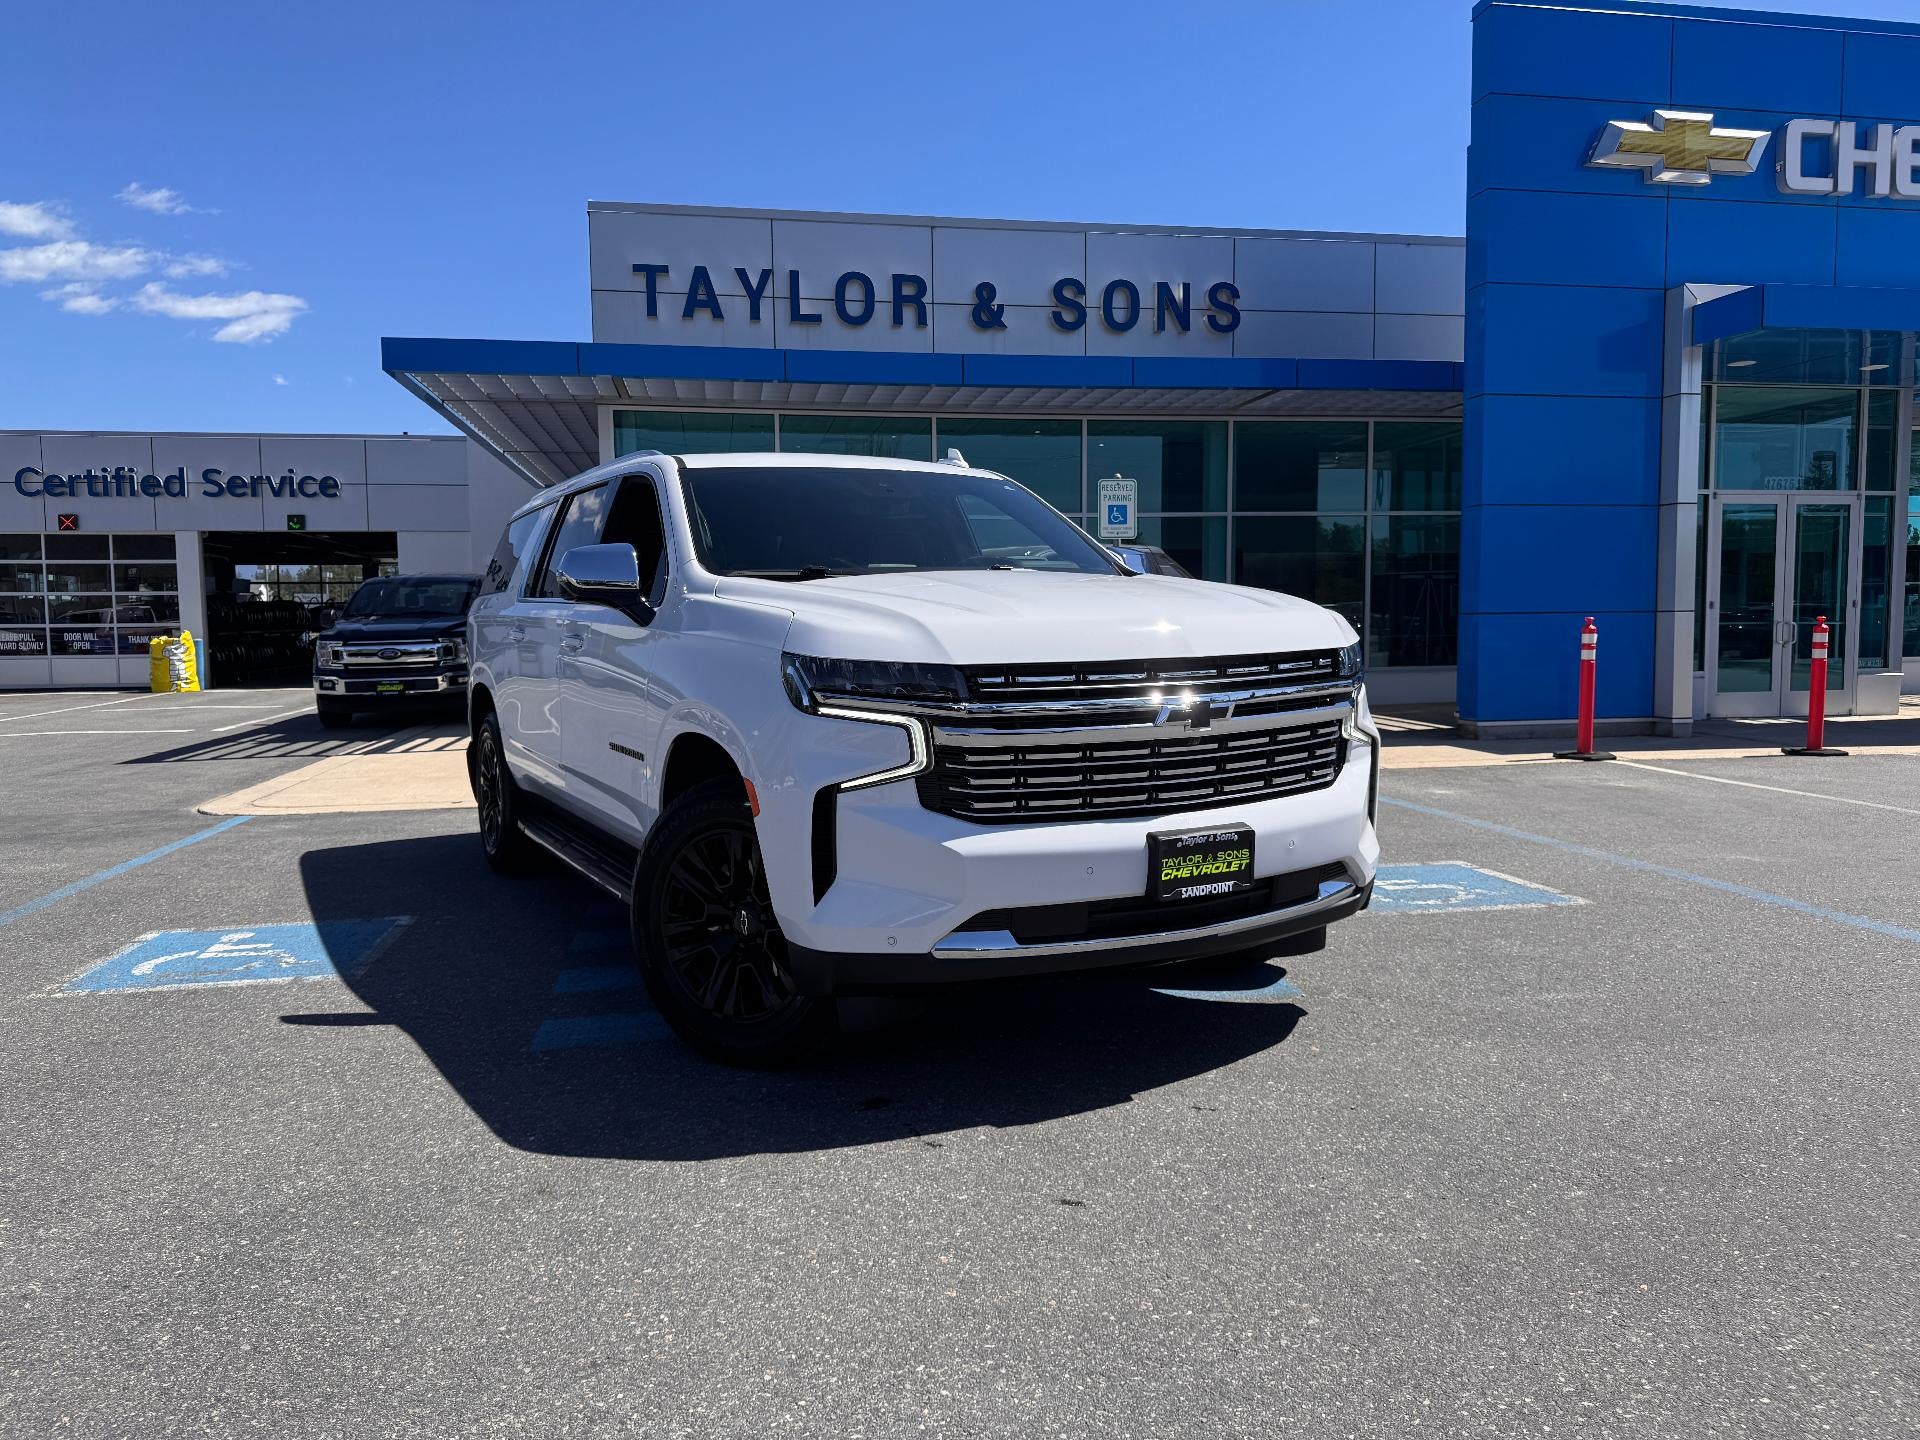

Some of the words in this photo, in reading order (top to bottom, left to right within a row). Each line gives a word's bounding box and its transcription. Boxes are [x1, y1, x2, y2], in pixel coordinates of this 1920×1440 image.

[632, 264, 928, 327] TAYLOR
[971, 281, 1008, 329] &
[1052, 277, 1241, 333] SONS
[14, 466, 188, 498] Certified
[202, 467, 342, 498] Service
[1101, 484, 1134, 492] RESERVED
[1103, 494, 1132, 502] PARKING
[19, 633, 36, 641] PULL
[63, 632, 82, 641] DOOR
[83, 632, 99, 641] WILL
[128, 635, 150, 644] THANK
[18, 641, 44, 650] SLOWLY
[73, 641, 90, 650] OPEN
[1215, 832, 1235, 842] Sons
[1161, 854, 1203, 868] TAYLOR
[1206, 853, 1214, 864] &
[1216, 849, 1250, 861] SONS
[1161, 860, 1250, 881] CHEVROLET
[1181, 881, 1234, 899] SANDPOINT
